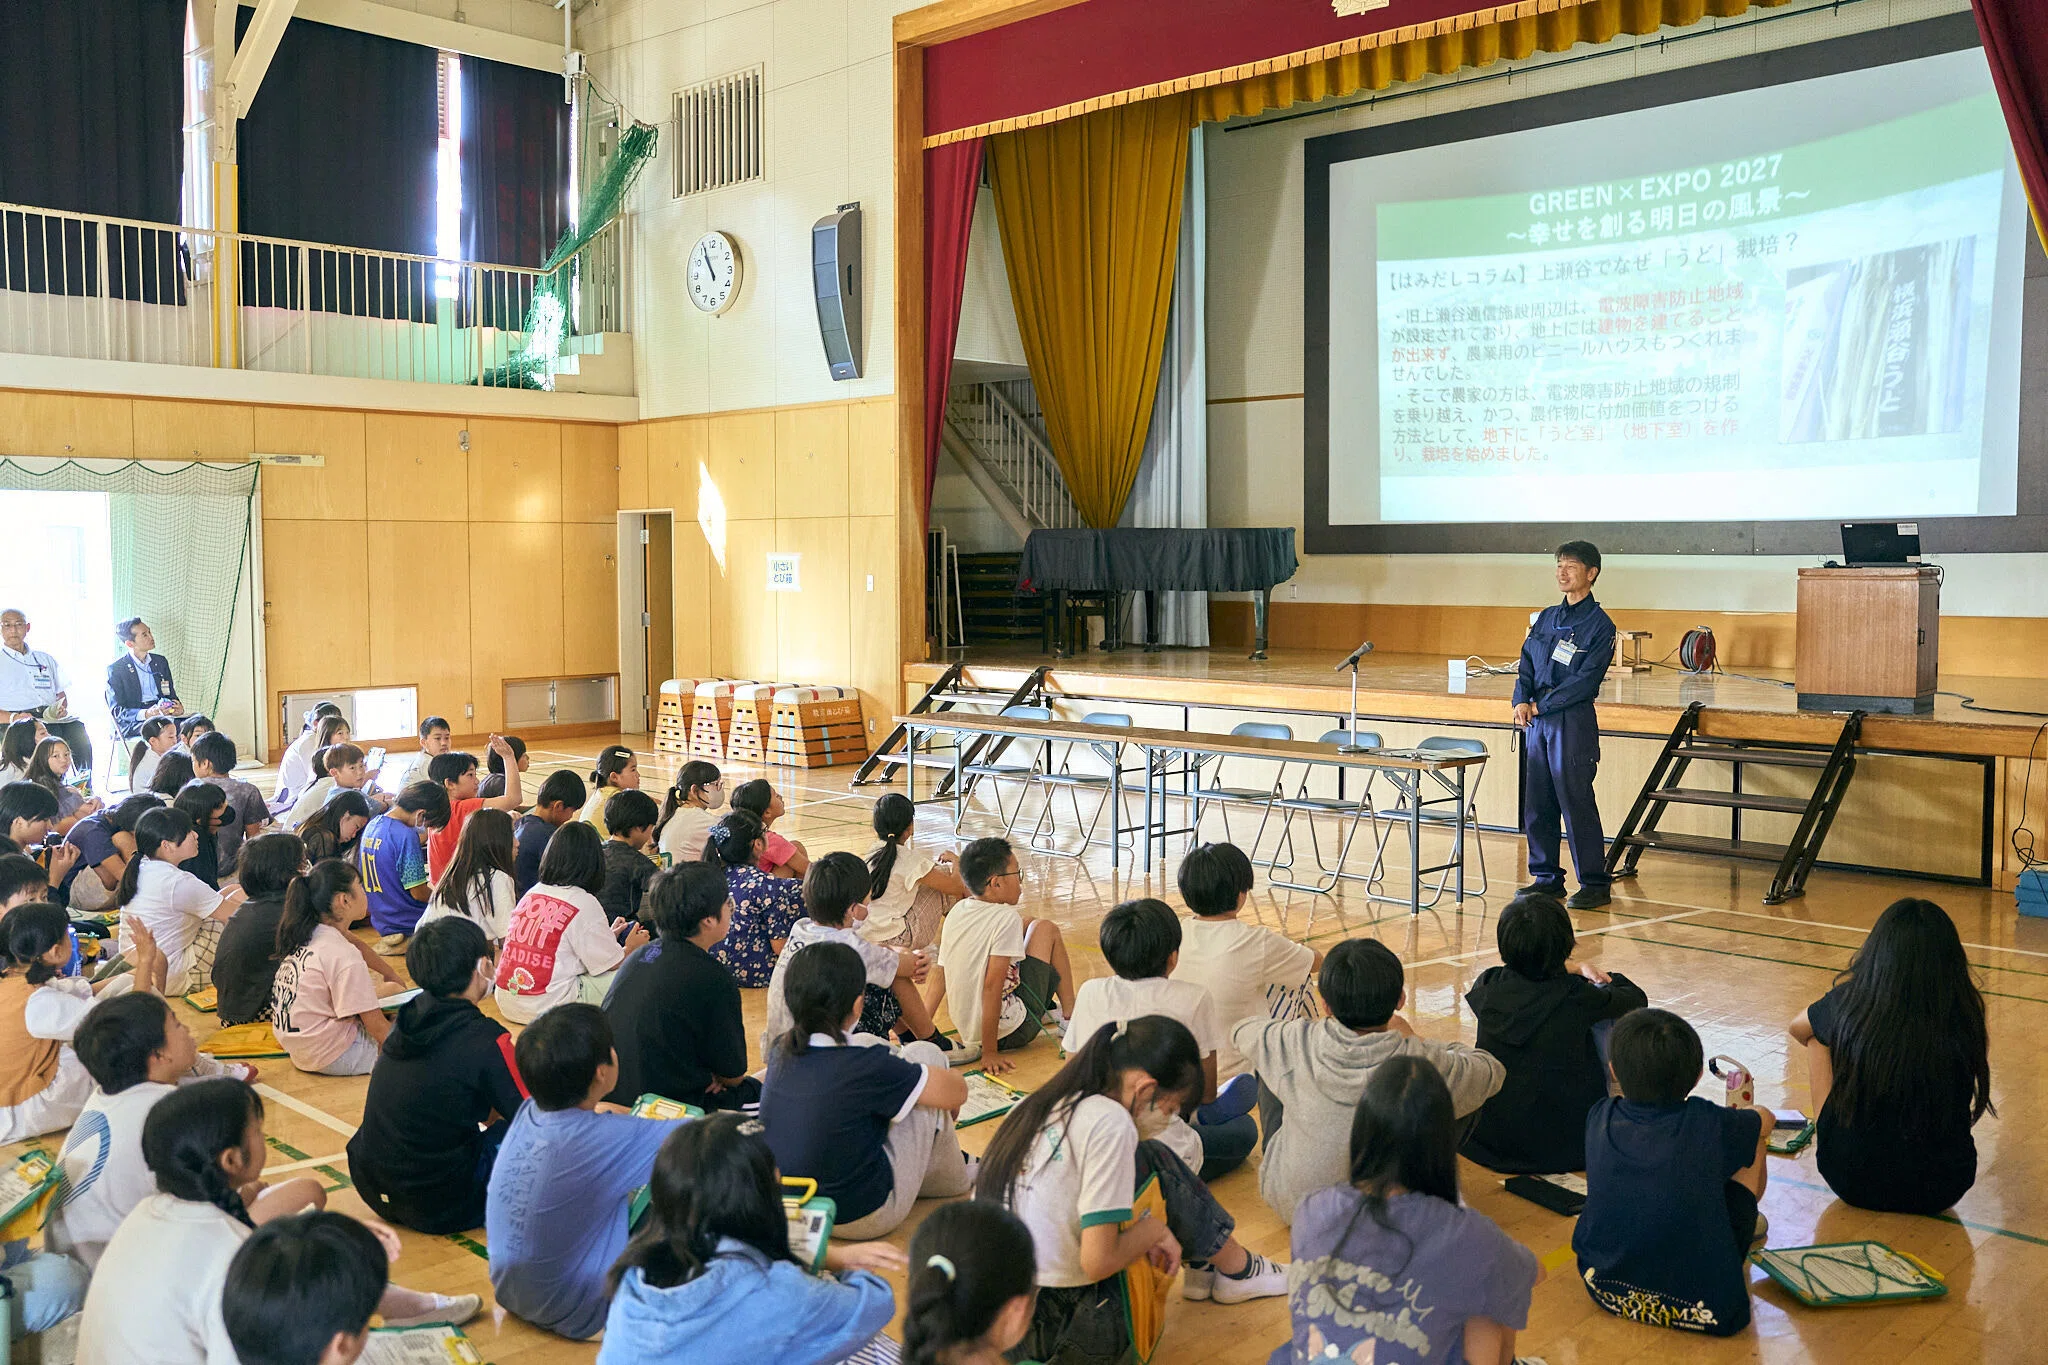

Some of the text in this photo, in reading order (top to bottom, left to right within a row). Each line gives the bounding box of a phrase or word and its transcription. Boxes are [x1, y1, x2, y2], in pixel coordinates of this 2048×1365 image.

[1719, 153, 1784, 186] 2027
[709, 240, 716, 249] 12
[725, 252, 730, 261] 2
[727, 265, 733, 275] 3
[724, 279, 731, 287] 4
[695, 285, 701, 294] 8
[702, 294, 708, 304] 7
[710, 297, 716, 306] 6
[719, 292, 726, 301] 5
[1392, 364, 1473, 382] せんでした。
[1392, 446, 1551, 463] り、栽培を始めました。
[773, 561, 793, 572] 小さい
[361, 852, 383, 893] 10
